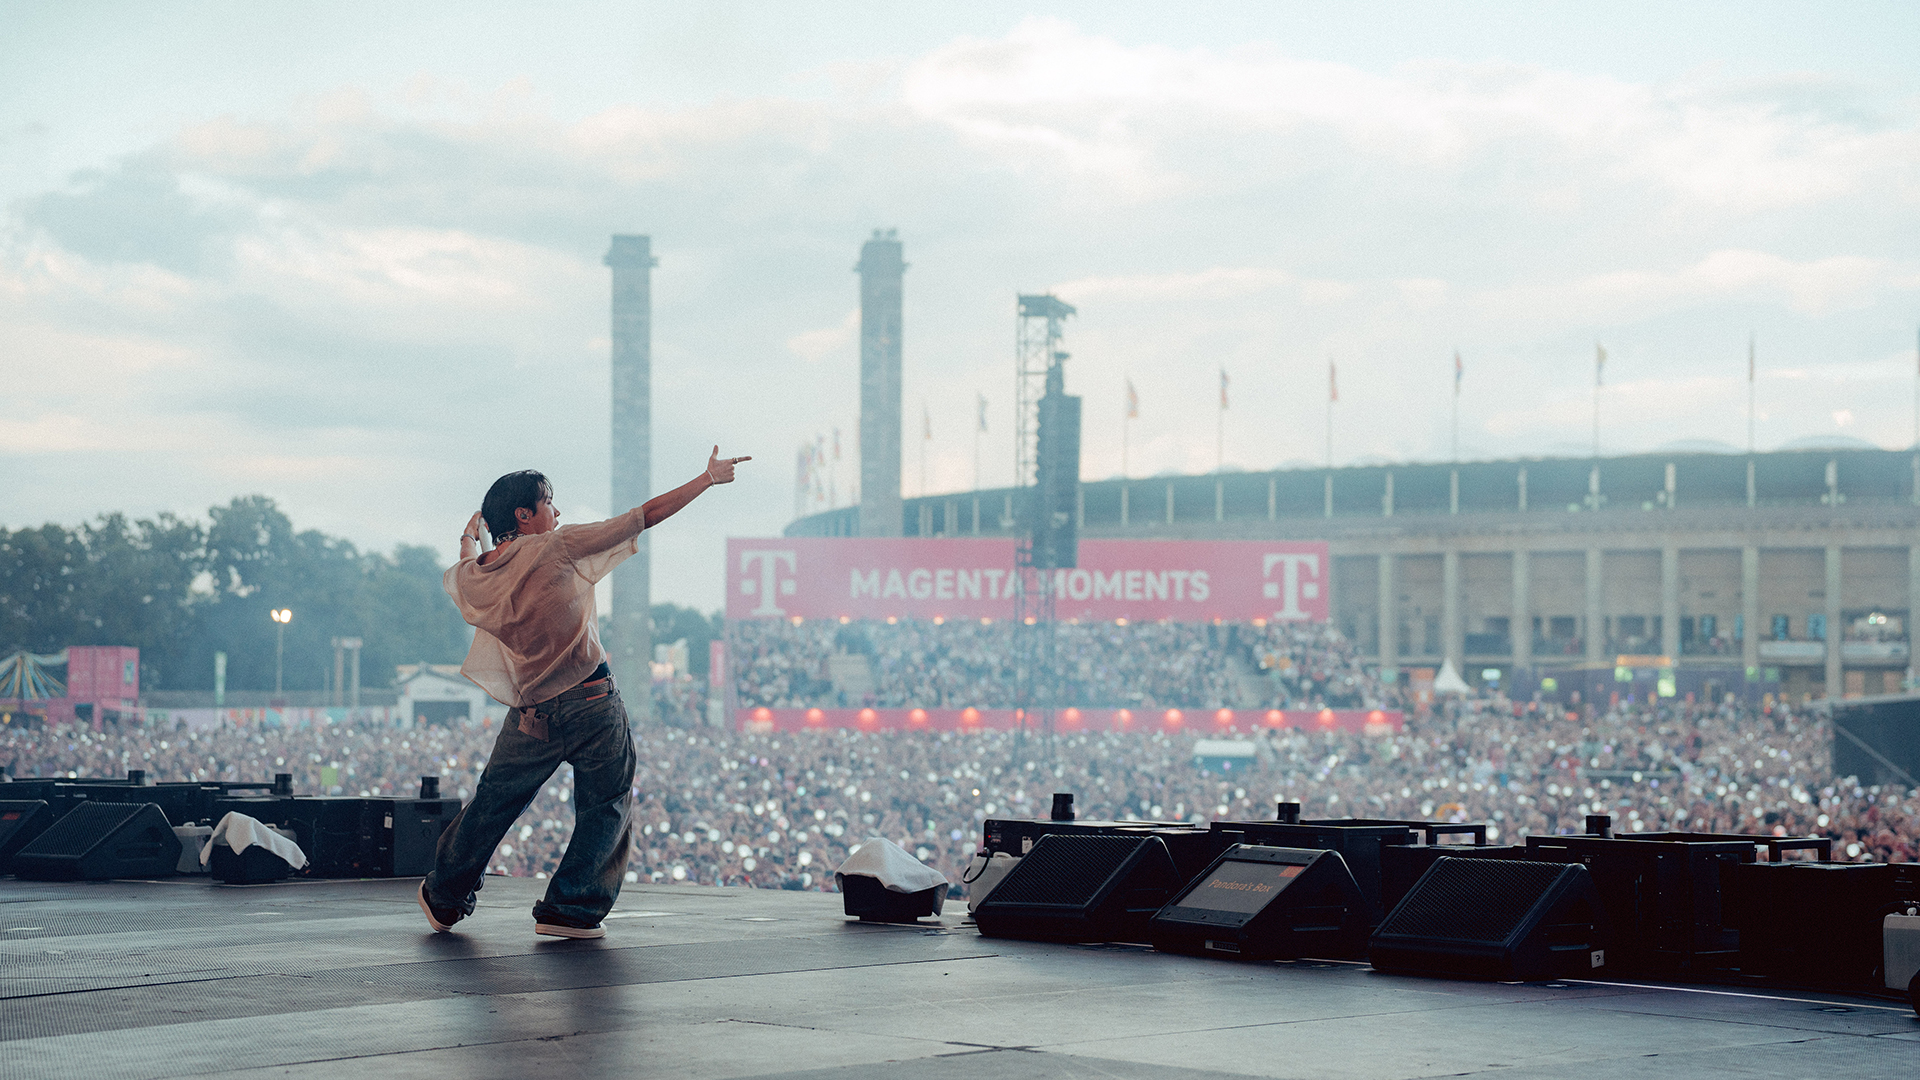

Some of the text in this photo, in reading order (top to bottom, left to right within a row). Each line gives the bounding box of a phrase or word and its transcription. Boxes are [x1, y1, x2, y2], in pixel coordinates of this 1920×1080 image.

[741, 550, 797, 617] T
[850, 567, 1210, 601] MAGENTA MOMENTS
[1263, 553, 1319, 619] T
[1208, 879, 1273, 892] Pandora's Box
